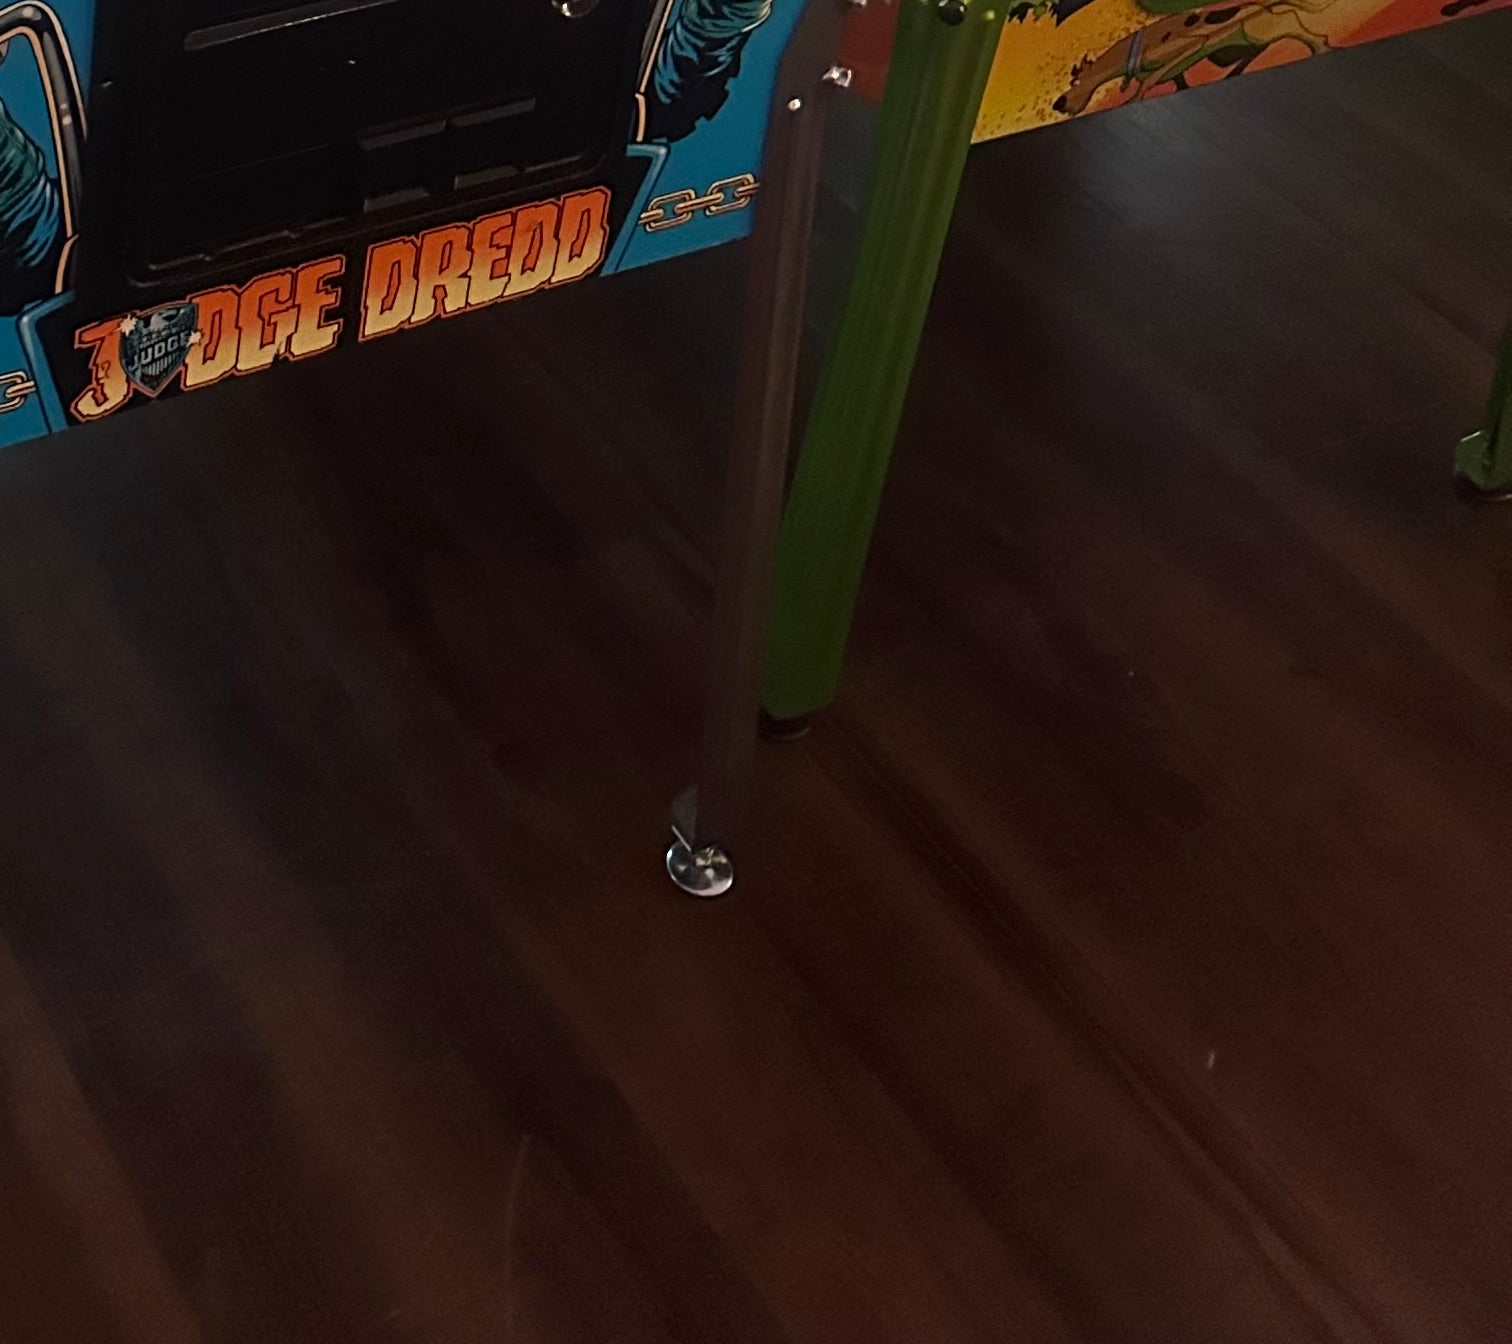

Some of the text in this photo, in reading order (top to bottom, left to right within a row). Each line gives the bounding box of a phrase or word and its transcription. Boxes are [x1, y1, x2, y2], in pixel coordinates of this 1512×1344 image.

[71, 185, 613, 423] JDGE DREDD
[128, 330, 190, 372] JUDGE
